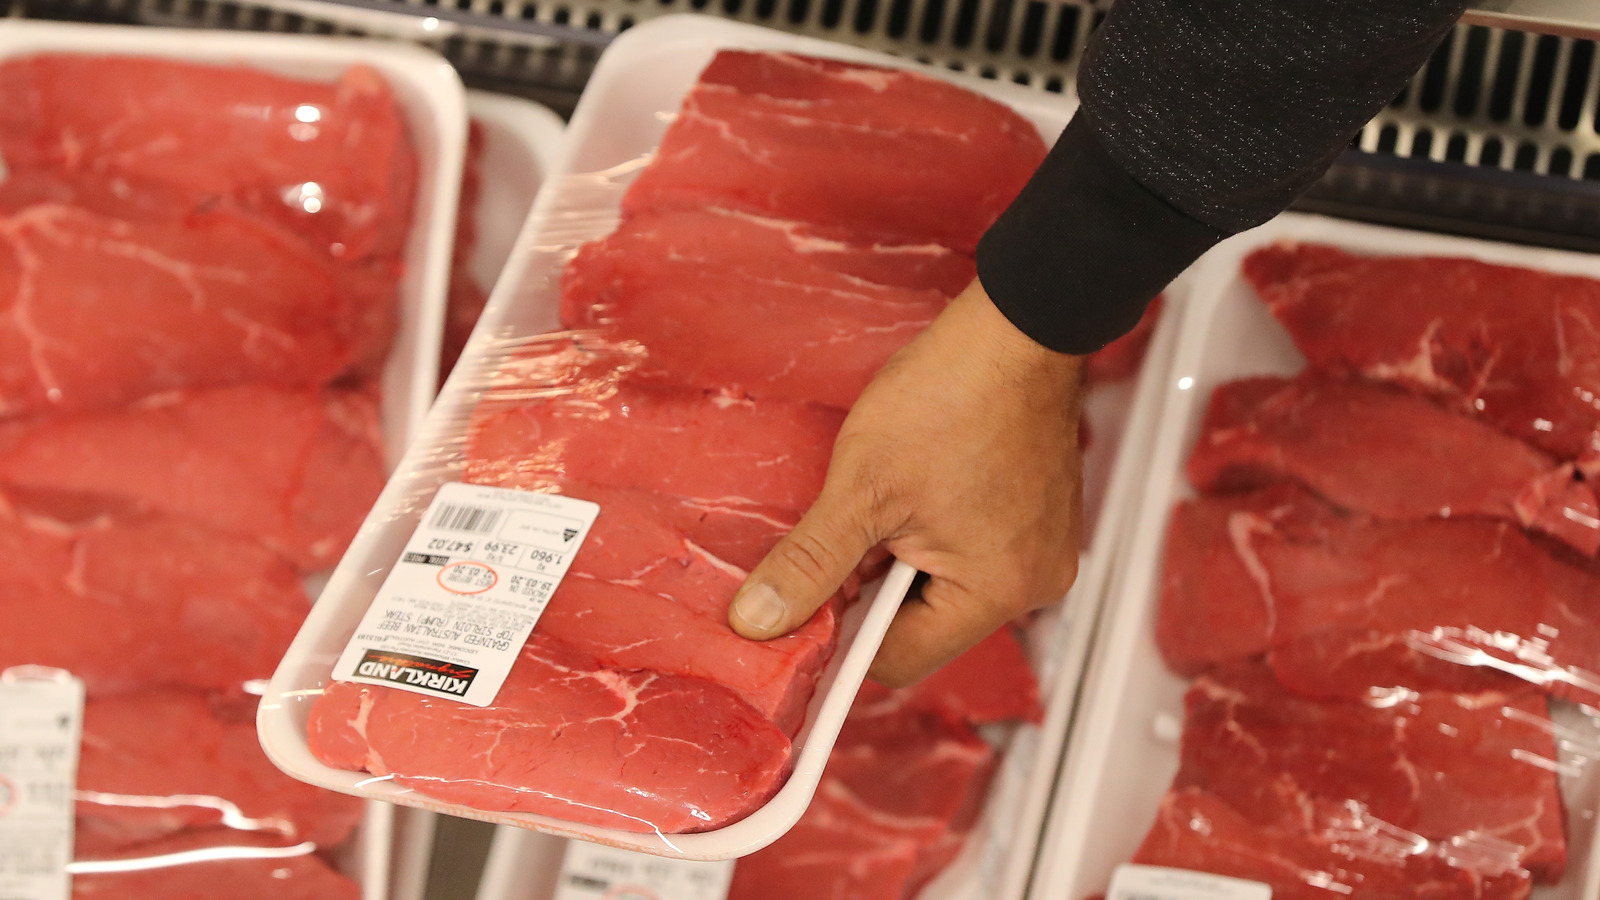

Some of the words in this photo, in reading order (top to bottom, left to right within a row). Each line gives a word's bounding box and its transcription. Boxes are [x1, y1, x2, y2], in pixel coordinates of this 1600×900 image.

[427, 538, 473, 553] $47.02
[484, 542, 518, 555] 23.99
[530, 550, 564, 565] 1.960
[446, 572, 473, 584] BEFORE
[453, 565, 495, 579] 22.03.20
[510, 576, 552, 591] 19.03.20
[519, 586, 549, 598] PACKED
[385, 609, 412, 622] STEAK
[415, 614, 448, 627] (RUMP)
[376, 620, 402, 631] BEEF
[404, 623, 461, 640] AUSTRALIAN
[452, 621, 493, 636] SIRLOIN
[495, 629, 515, 641] TOP
[463, 635, 510, 651] GRAINFED
[367, 655, 474, 677] Signature
[359, 661, 468, 693] KIRKLAND
